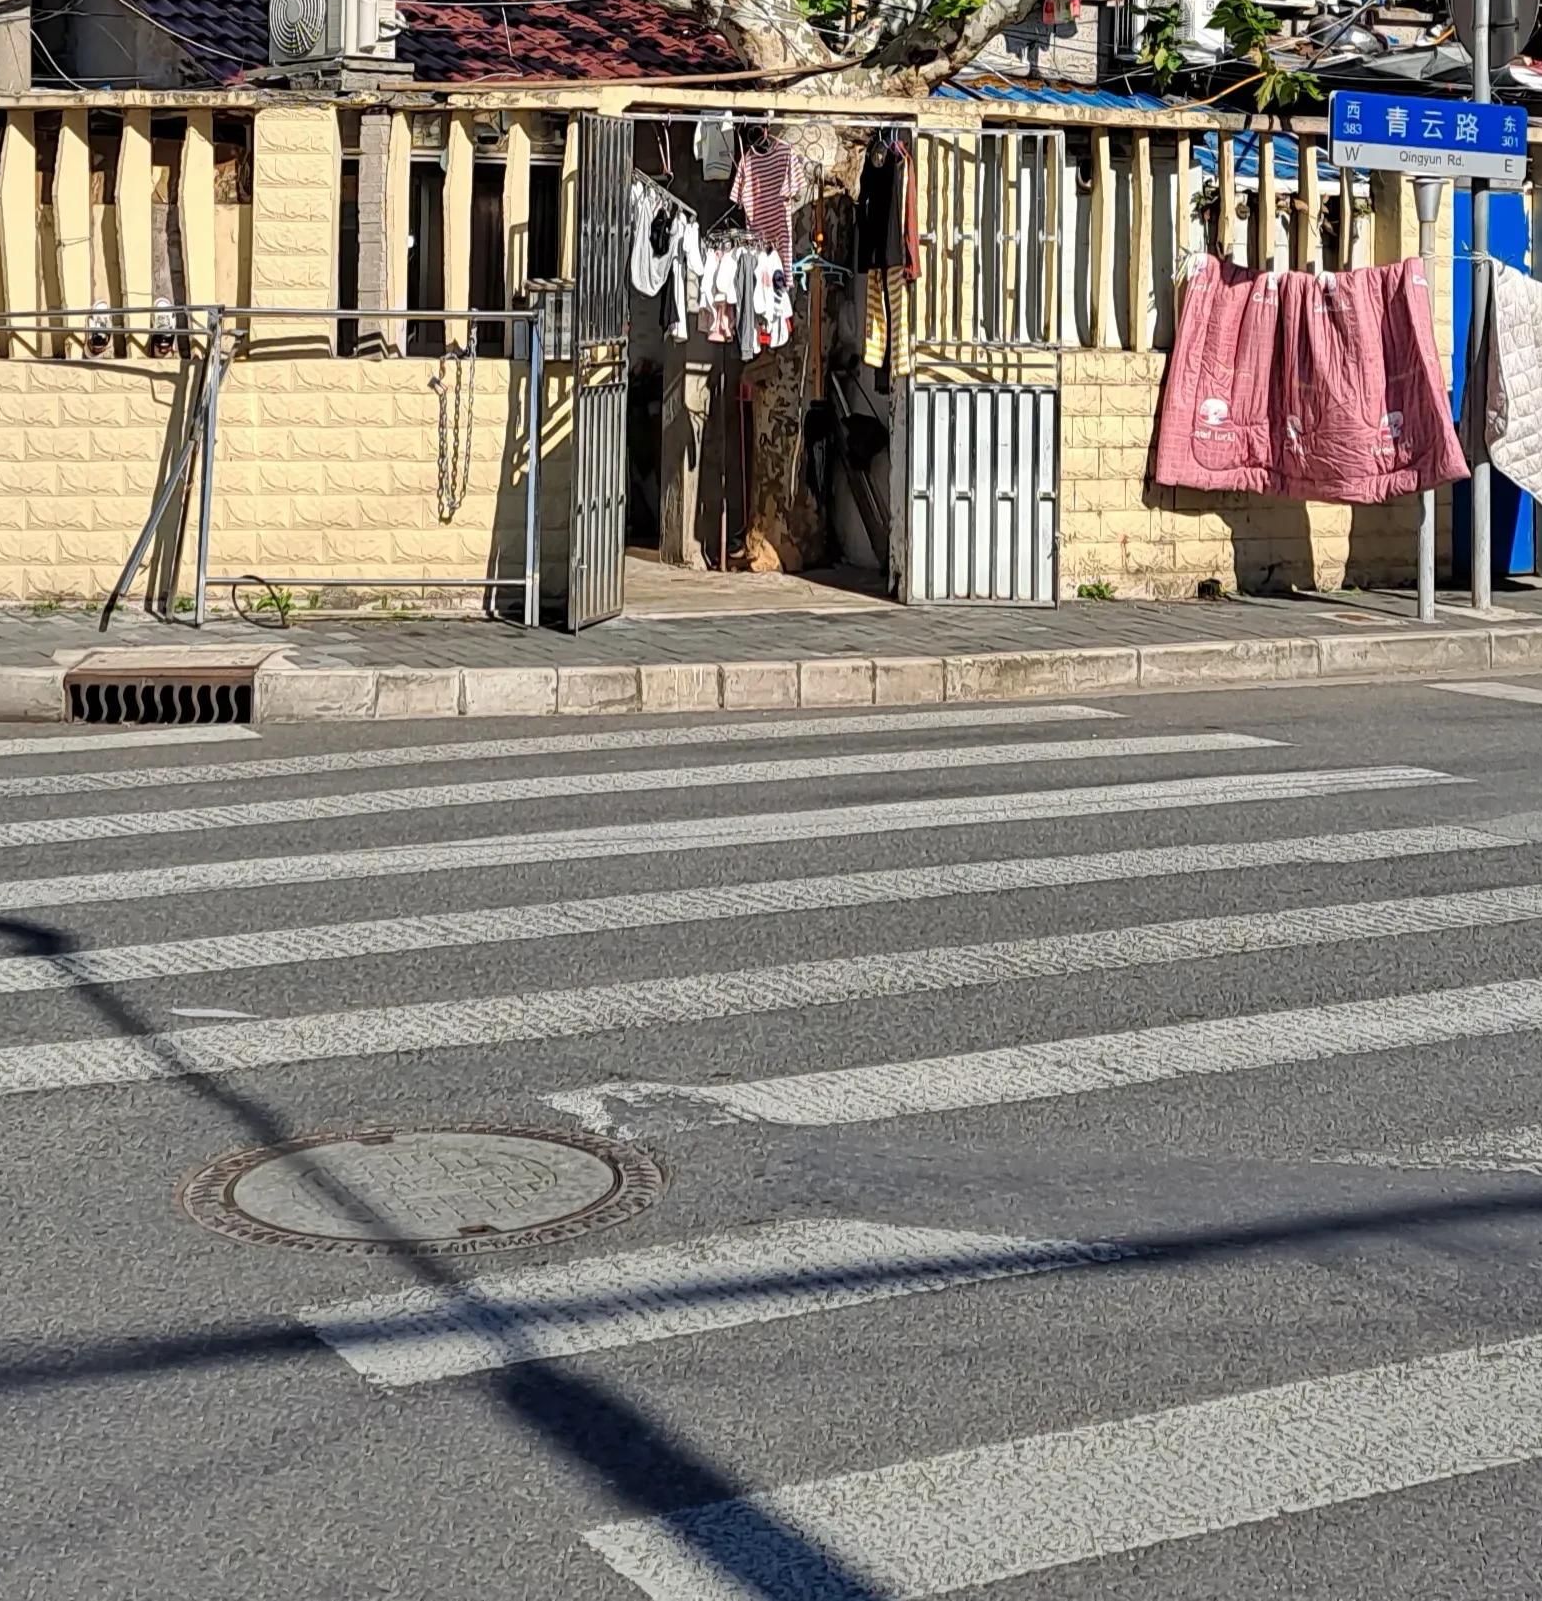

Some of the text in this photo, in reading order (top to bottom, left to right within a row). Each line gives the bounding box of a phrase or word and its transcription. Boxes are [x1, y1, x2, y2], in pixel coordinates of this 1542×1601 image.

[1347, 101, 1361, 118] 西
[1343, 122, 1362, 135] 383
[1386, 106, 1479, 143] 青云路
[1503, 115, 1517, 133] 东
[1501, 135, 1519, 148] 301
[1345, 146, 1360, 161] W
[1400, 151, 1465, 167] Qingyun Rd.
[1505, 159, 1514, 173] E
